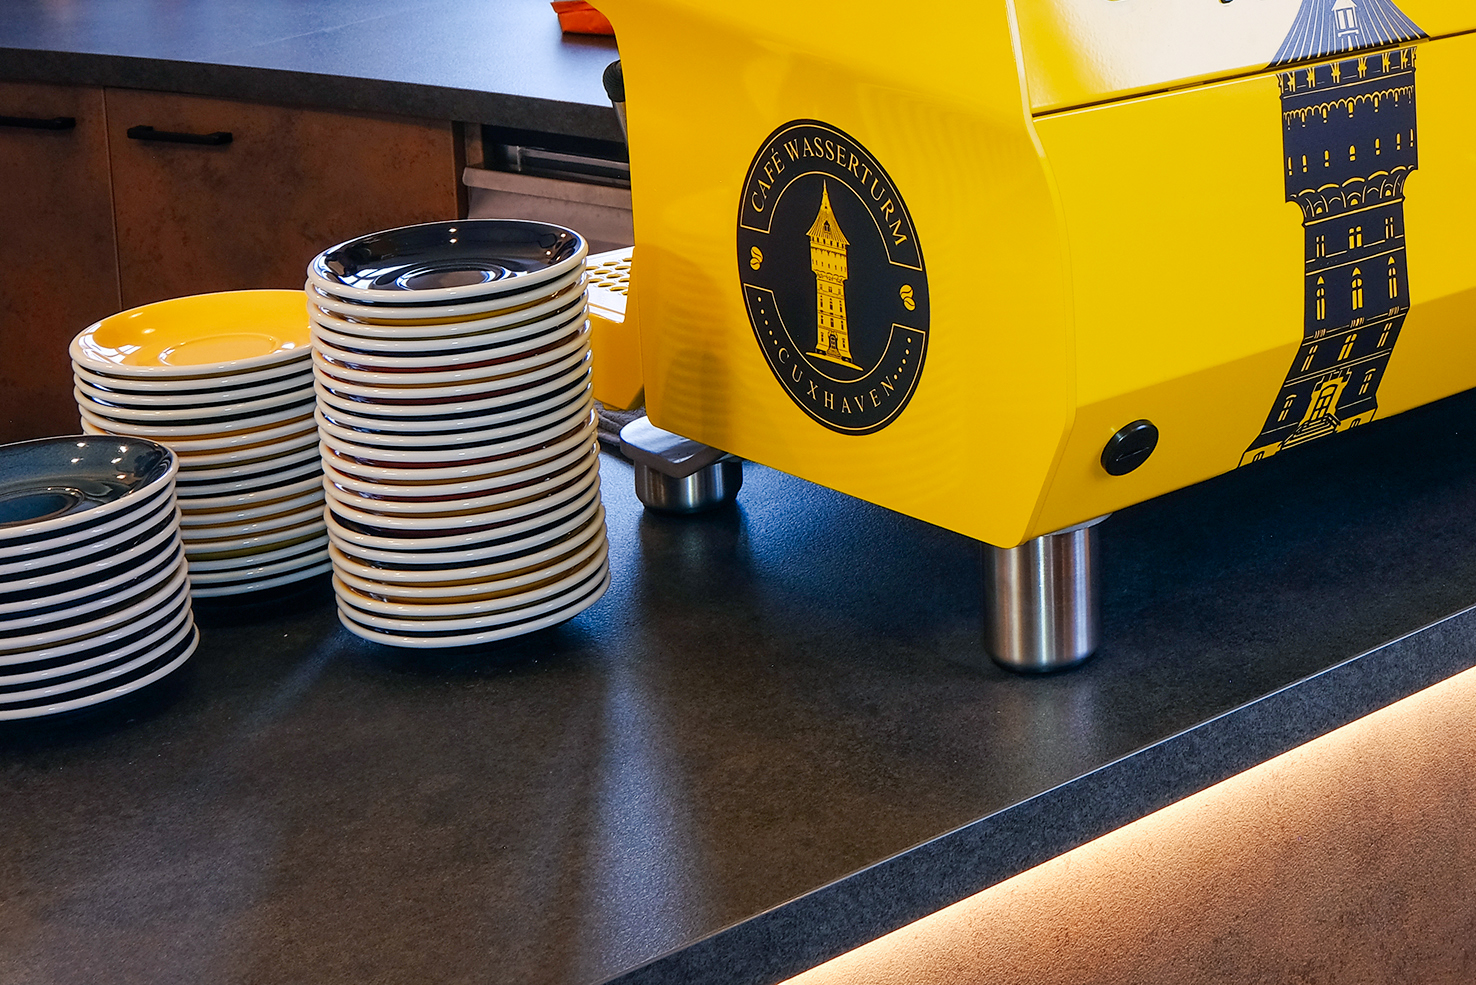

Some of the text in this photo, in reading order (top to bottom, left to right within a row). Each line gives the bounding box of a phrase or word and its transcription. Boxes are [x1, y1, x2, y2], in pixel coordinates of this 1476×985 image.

[751, 137, 907, 246] CAFÉ WASSERTURM
[778, 347, 895, 414] CUXHAVEN
